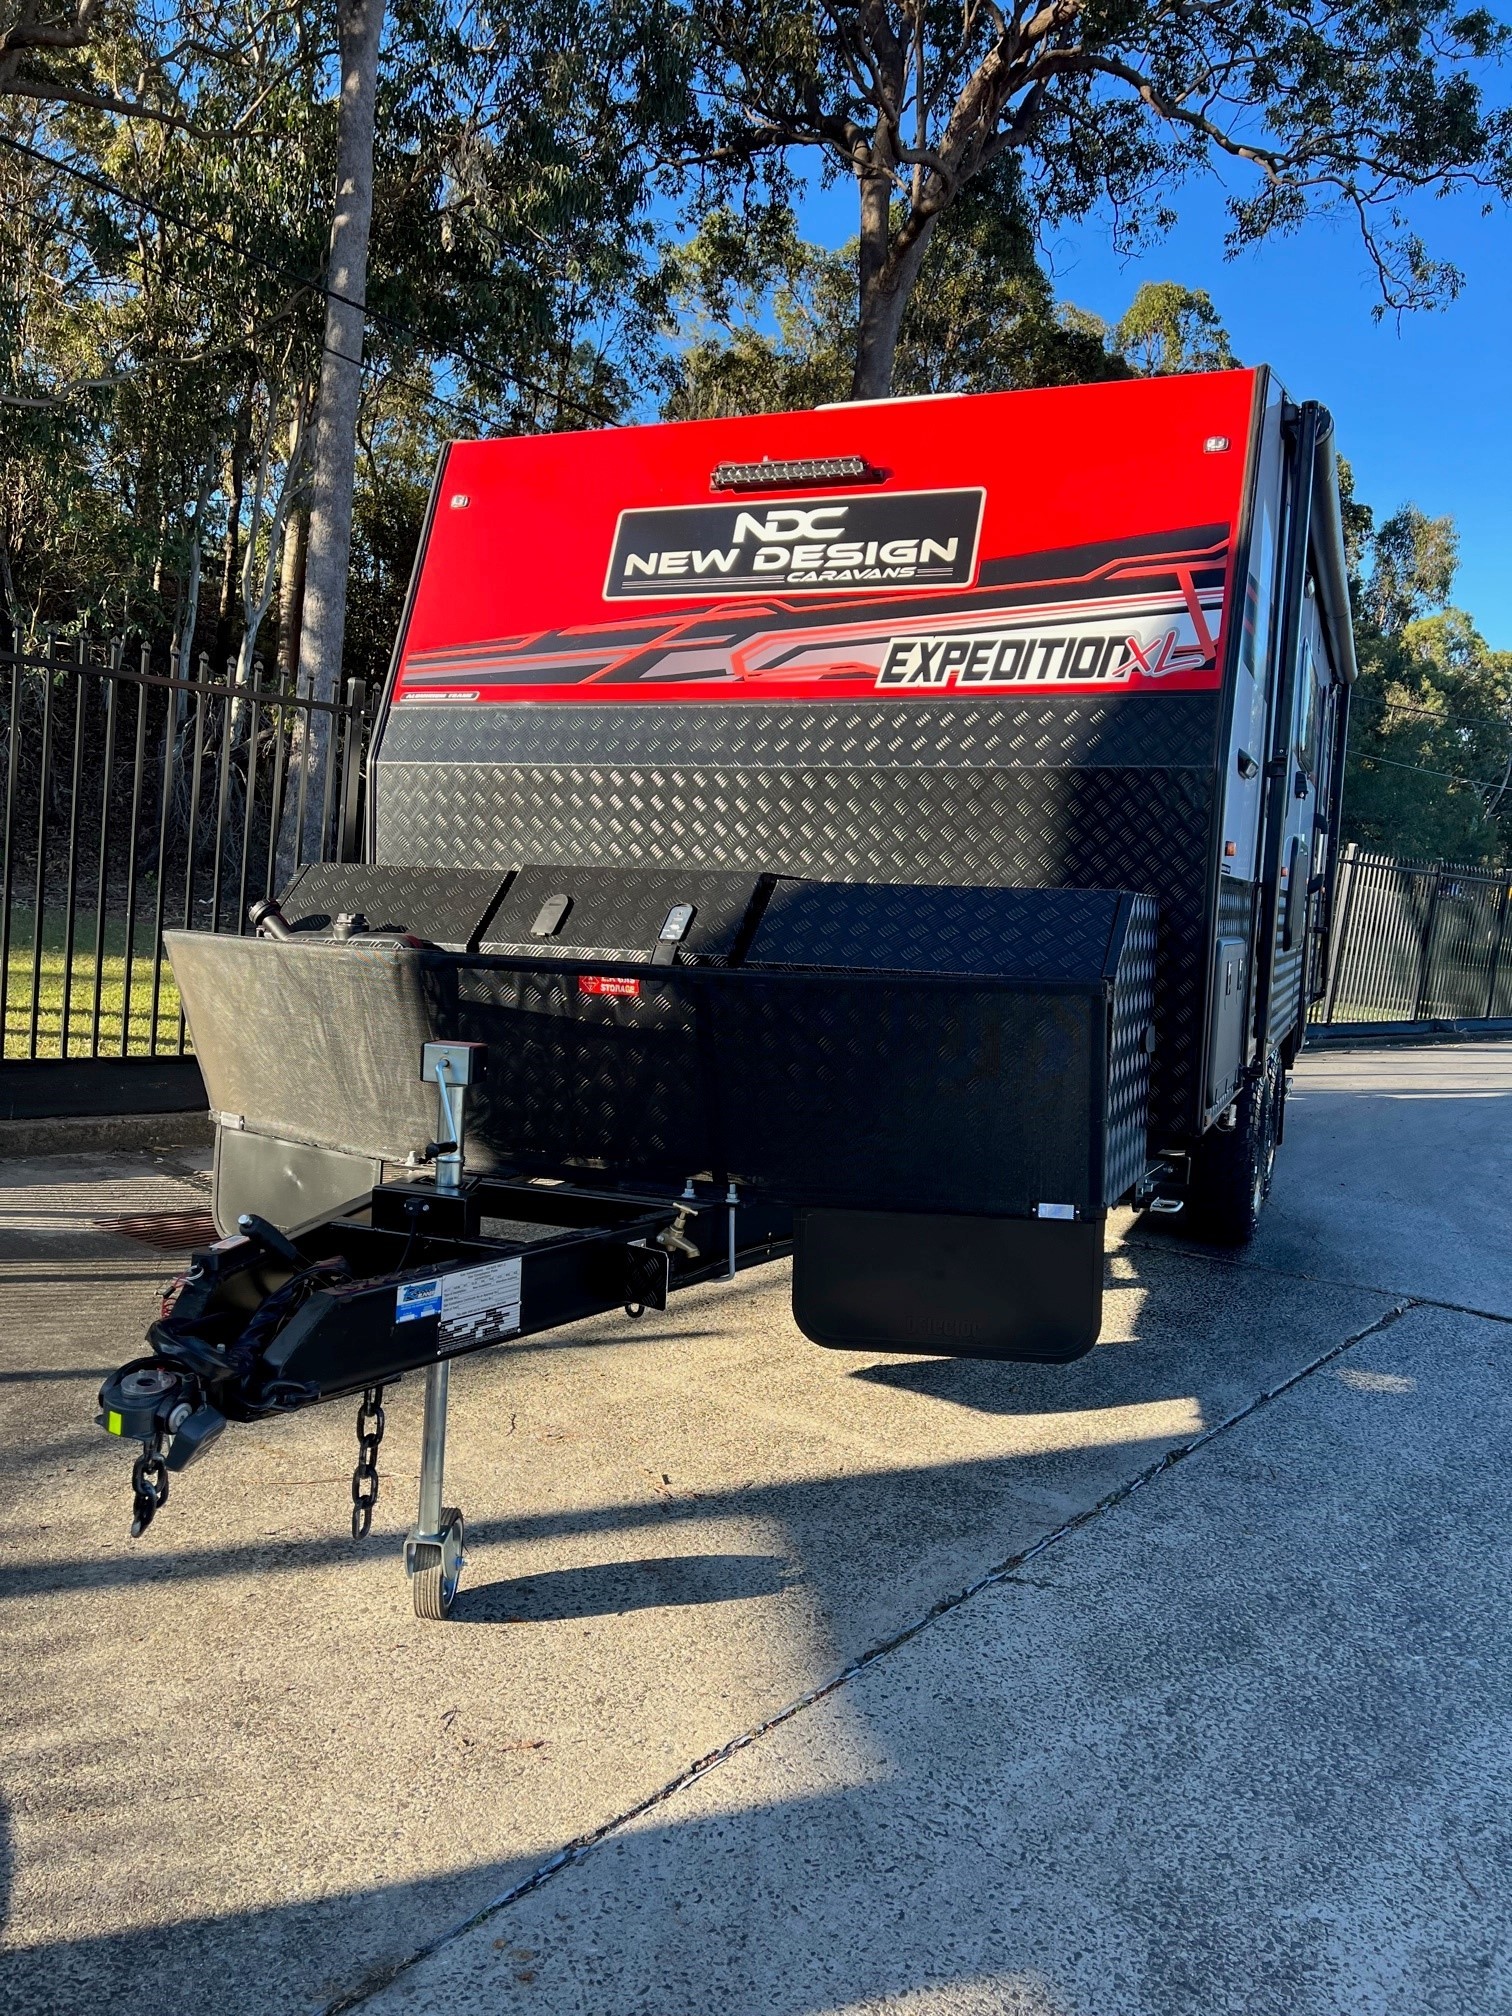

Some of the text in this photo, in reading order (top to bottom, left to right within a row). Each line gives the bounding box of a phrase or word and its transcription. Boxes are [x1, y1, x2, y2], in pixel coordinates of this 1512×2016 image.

[732, 506, 849, 544] NDC
[624, 536, 959, 576] NEW DESIGN
[786, 566, 918, 584] CARAVANS
[880, 630, 1204, 683] EXPEDITION XL
[600, 983, 635, 993] STORAGE
